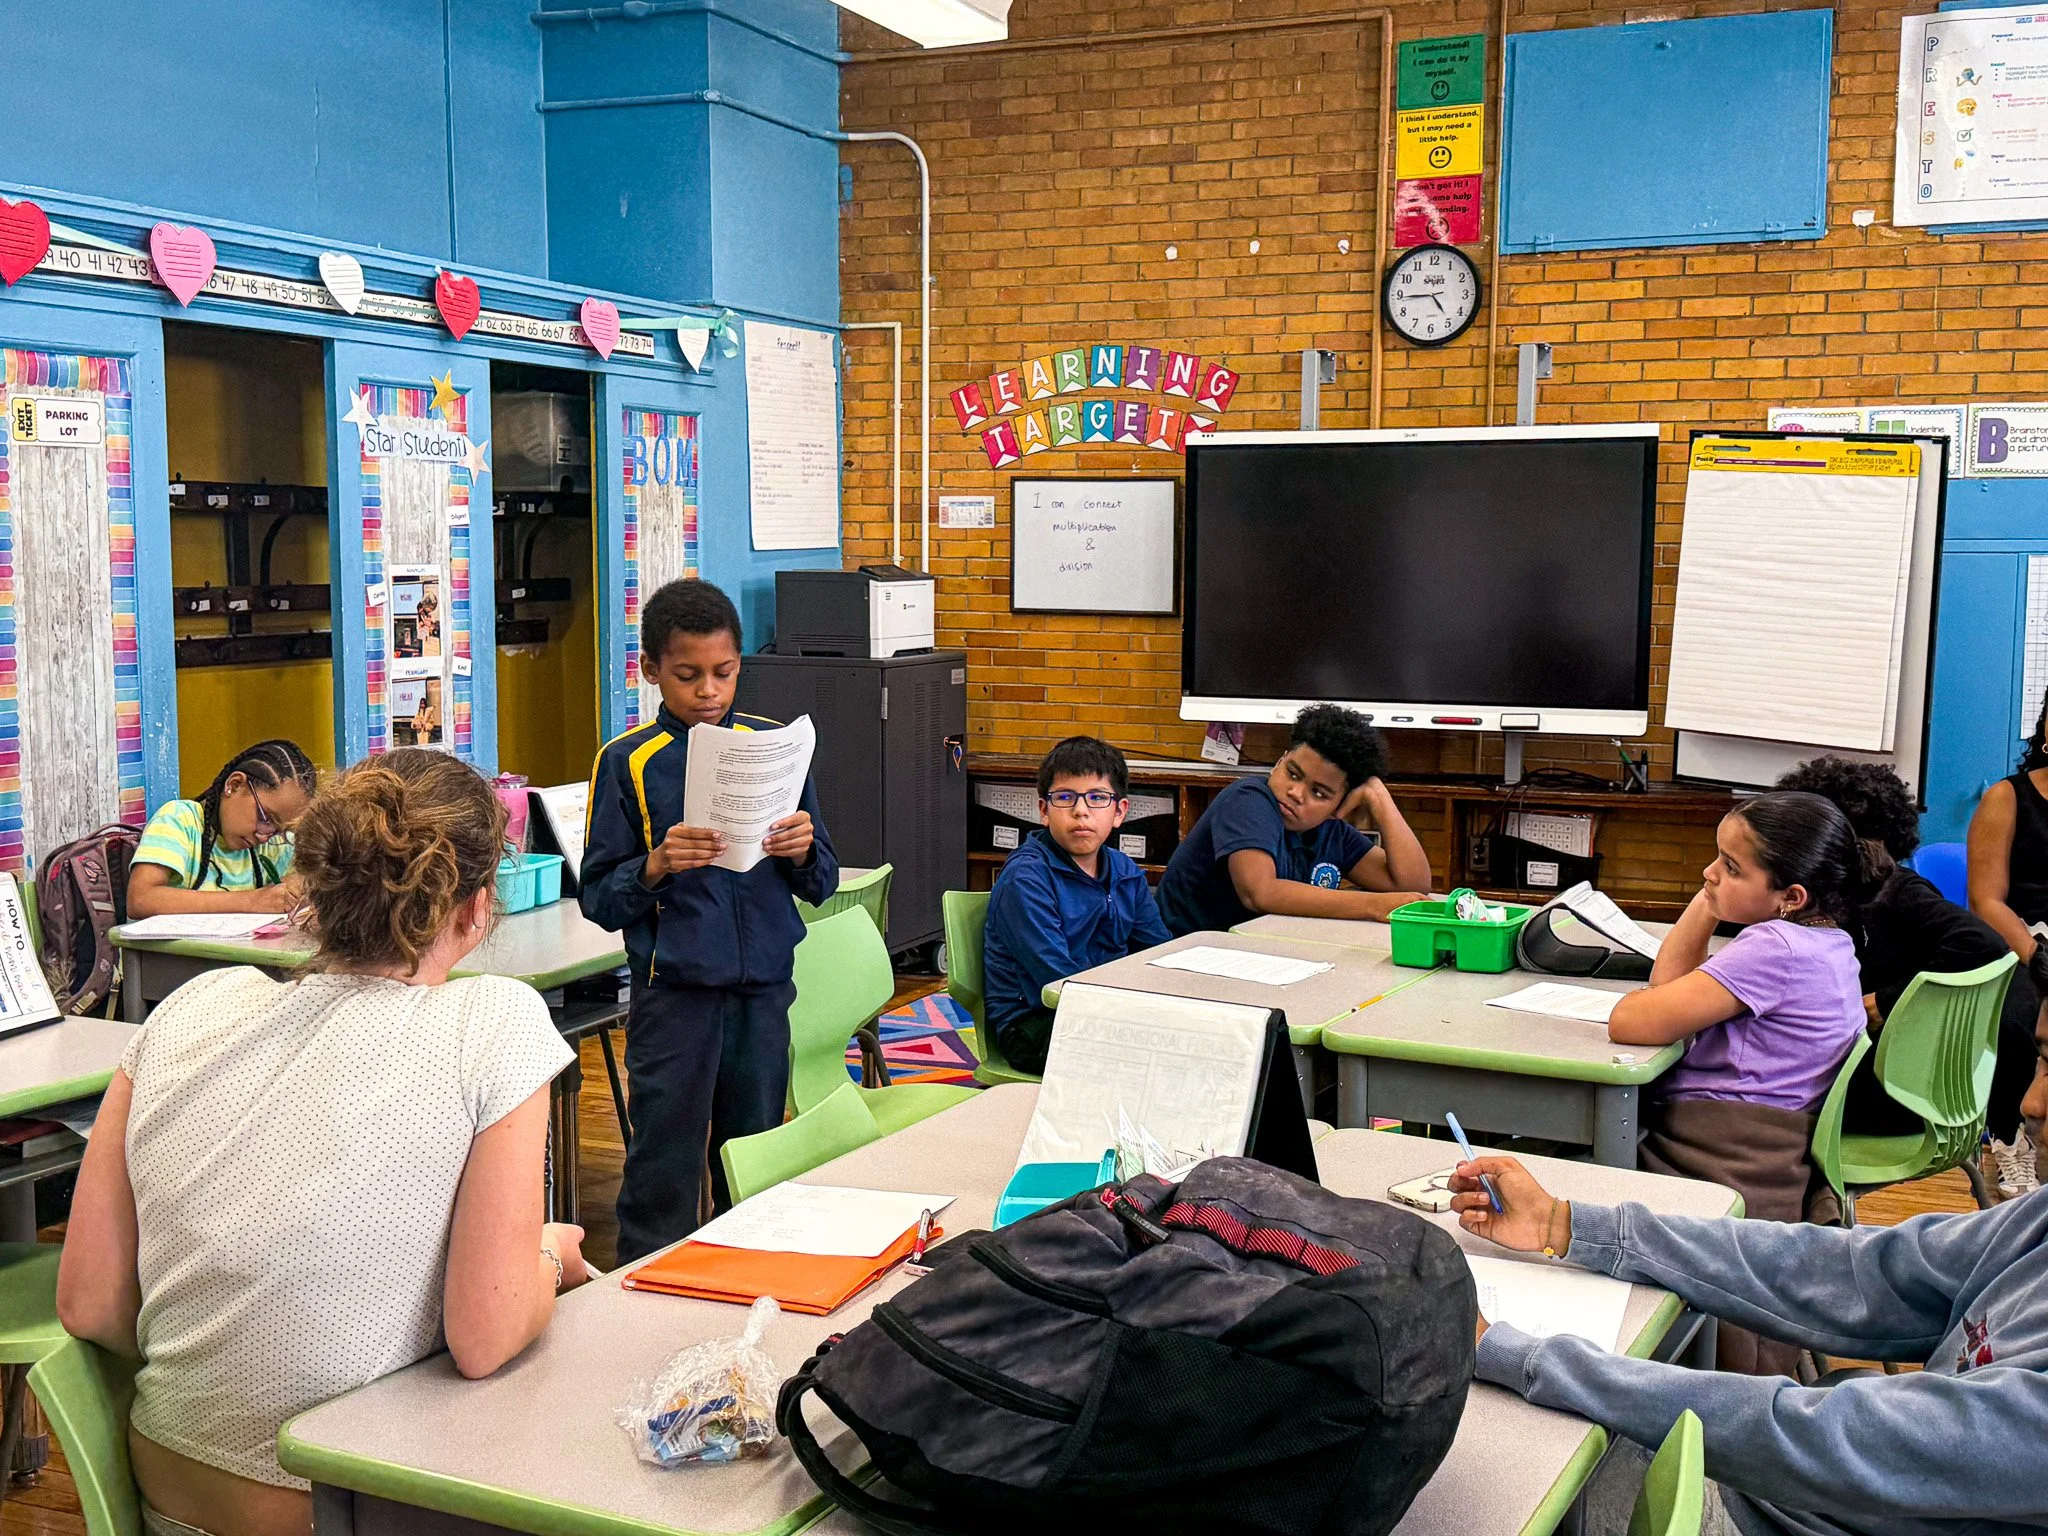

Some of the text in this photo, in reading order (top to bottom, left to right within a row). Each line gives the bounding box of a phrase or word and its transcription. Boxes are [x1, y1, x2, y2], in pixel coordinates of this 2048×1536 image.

[1458, 54, 1469, 63] by
[1424, 67, 1457, 79] myself.
[1405, 114, 1426, 122] think
[1407, 125, 1420, 133] but
[1426, 124, 1443, 133] may
[1445, 122, 1464, 130] need
[1419, 134, 1459, 144] little help.
[60, 250, 80, 268] 40
[88, 253, 102, 271] 41
[107, 256, 123, 274] 42
[129, 258, 148, 277] 43
[1429, 255, 1440, 266] 12
[1448, 260, 1453, 271] 1
[1412, 261, 1422, 272] 11
[1401, 273, 1413, 284] 10
[1458, 272, 1466, 283] 2
[222, 274, 236, 291] 47
[241, 277, 257, 295] 48
[263, 280, 277, 298] 49
[281, 285, 296, 301] 50
[301, 287, 312, 303] 51
[317, 288, 333, 306] 52
[1396, 289, 1404, 301] 9
[1461, 289, 1469, 300] 3
[1399, 306, 1407, 317] 8
[1456, 306, 1464, 317] 4
[1412, 318, 1419, 329] 7
[1427, 323, 1434, 334] 6
[1444, 317, 1452, 329] 5
[500, 320, 512, 332] 63
[527, 322, 538, 336] 65
[541, 323, 553, 338] 66
[553, 326, 565, 340] 67
[568, 328, 579, 341] 68
[619, 335, 652, 352] 72 73 74
[958, 346, 1230, 416] LEARNING
[17, 407, 26, 431] EXIT
[25, 402, 34, 438] TICKET
[45, 410, 89, 421] PARKING
[59, 427, 78, 437] LOT
[1905, 425, 1945, 434] Underline
[366, 428, 464, 458] Star Student
[1977, 417, 2009, 464] B
[2009, 435, 2027, 443] and
[631, 434, 696, 488] BOM
[1033, 492, 1123, 510] I can connect
[1052, 520, 1117, 534] multiplication
[1085, 537, 1096, 551] &
[6, 898, 20, 930] HOW
